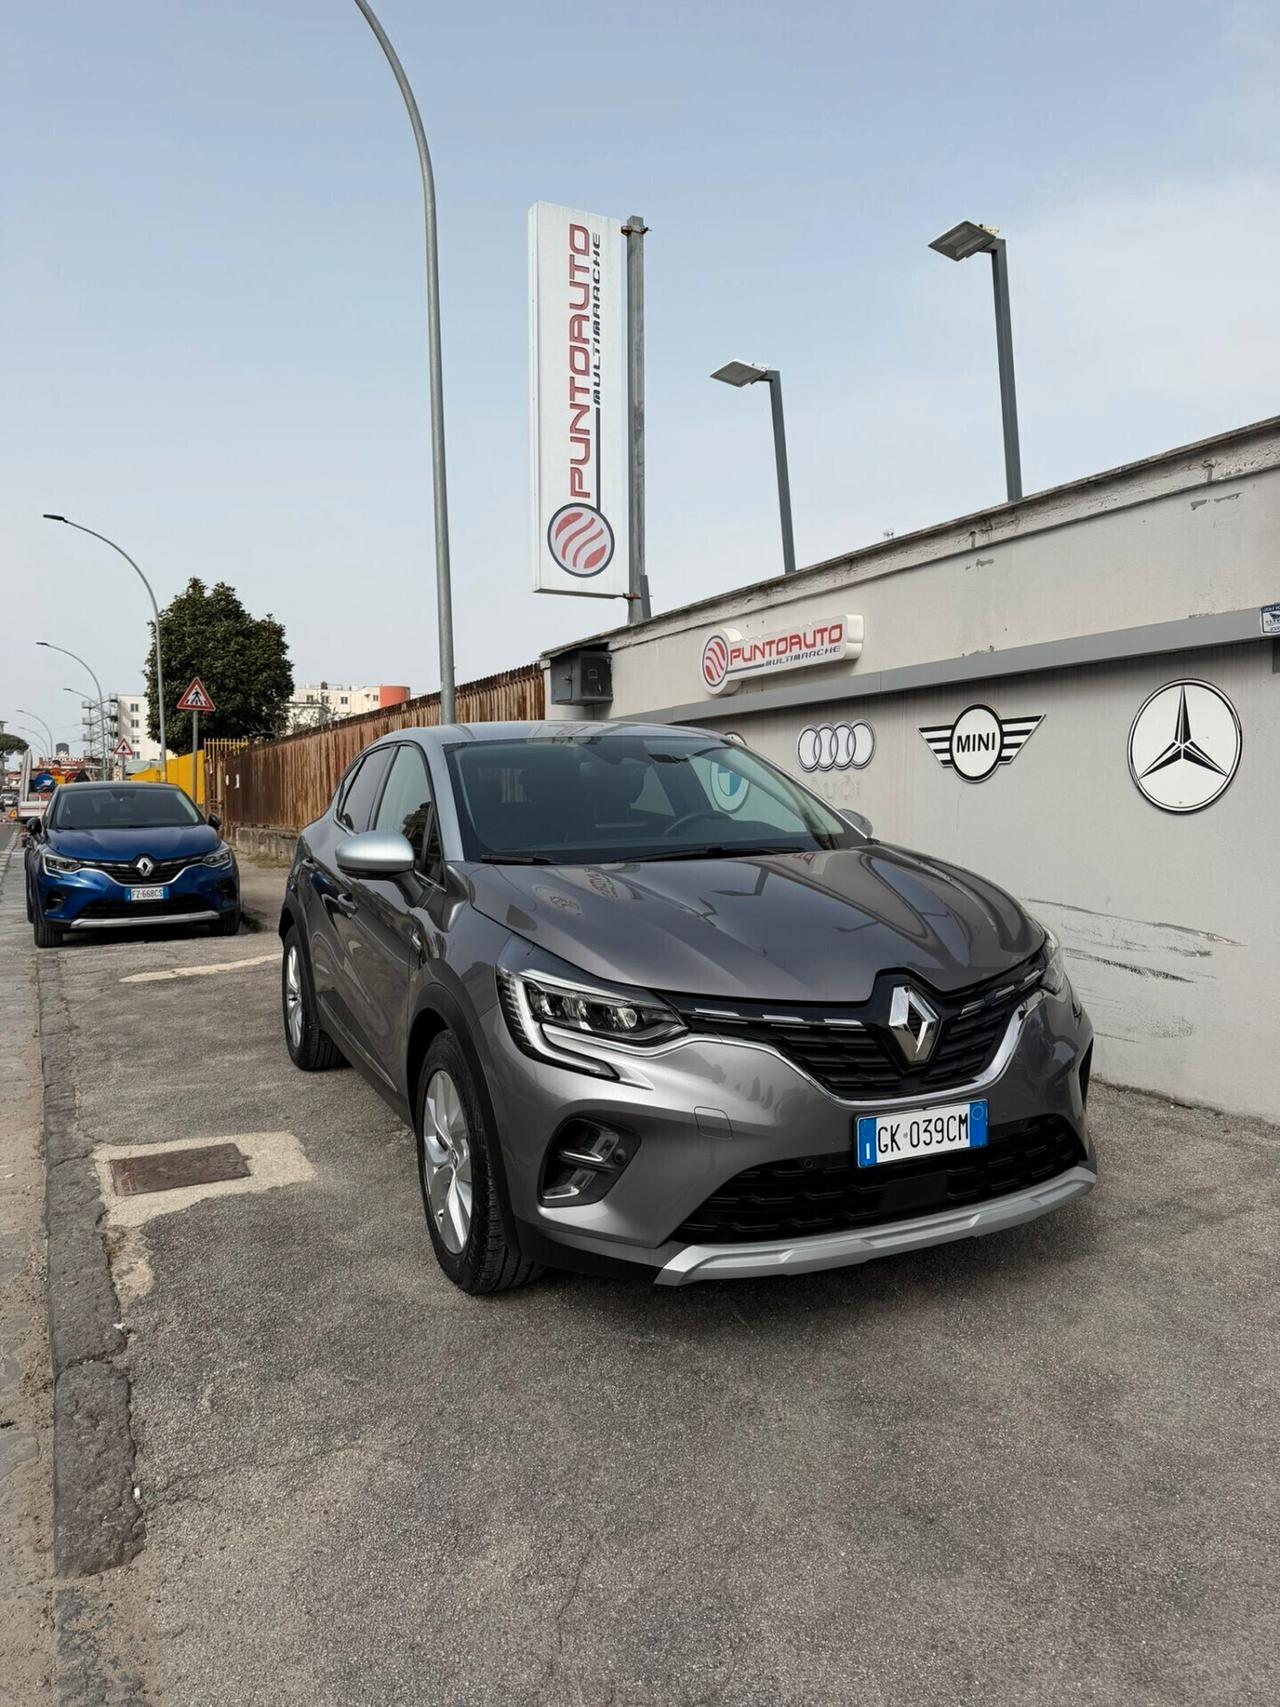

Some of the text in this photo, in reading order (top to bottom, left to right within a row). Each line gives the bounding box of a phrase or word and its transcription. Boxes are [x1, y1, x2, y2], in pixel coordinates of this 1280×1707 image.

[592, 232, 601, 407] MULTIMARCHE
[568, 223, 592, 498] PUNTOAUTO
[730, 623, 843, 666] PUNTOAUTO
[764, 645, 842, 667] MULTIMARCHE
[956, 732, 996, 753] MINI
[877, 1112, 969, 1154] GK 039CM
